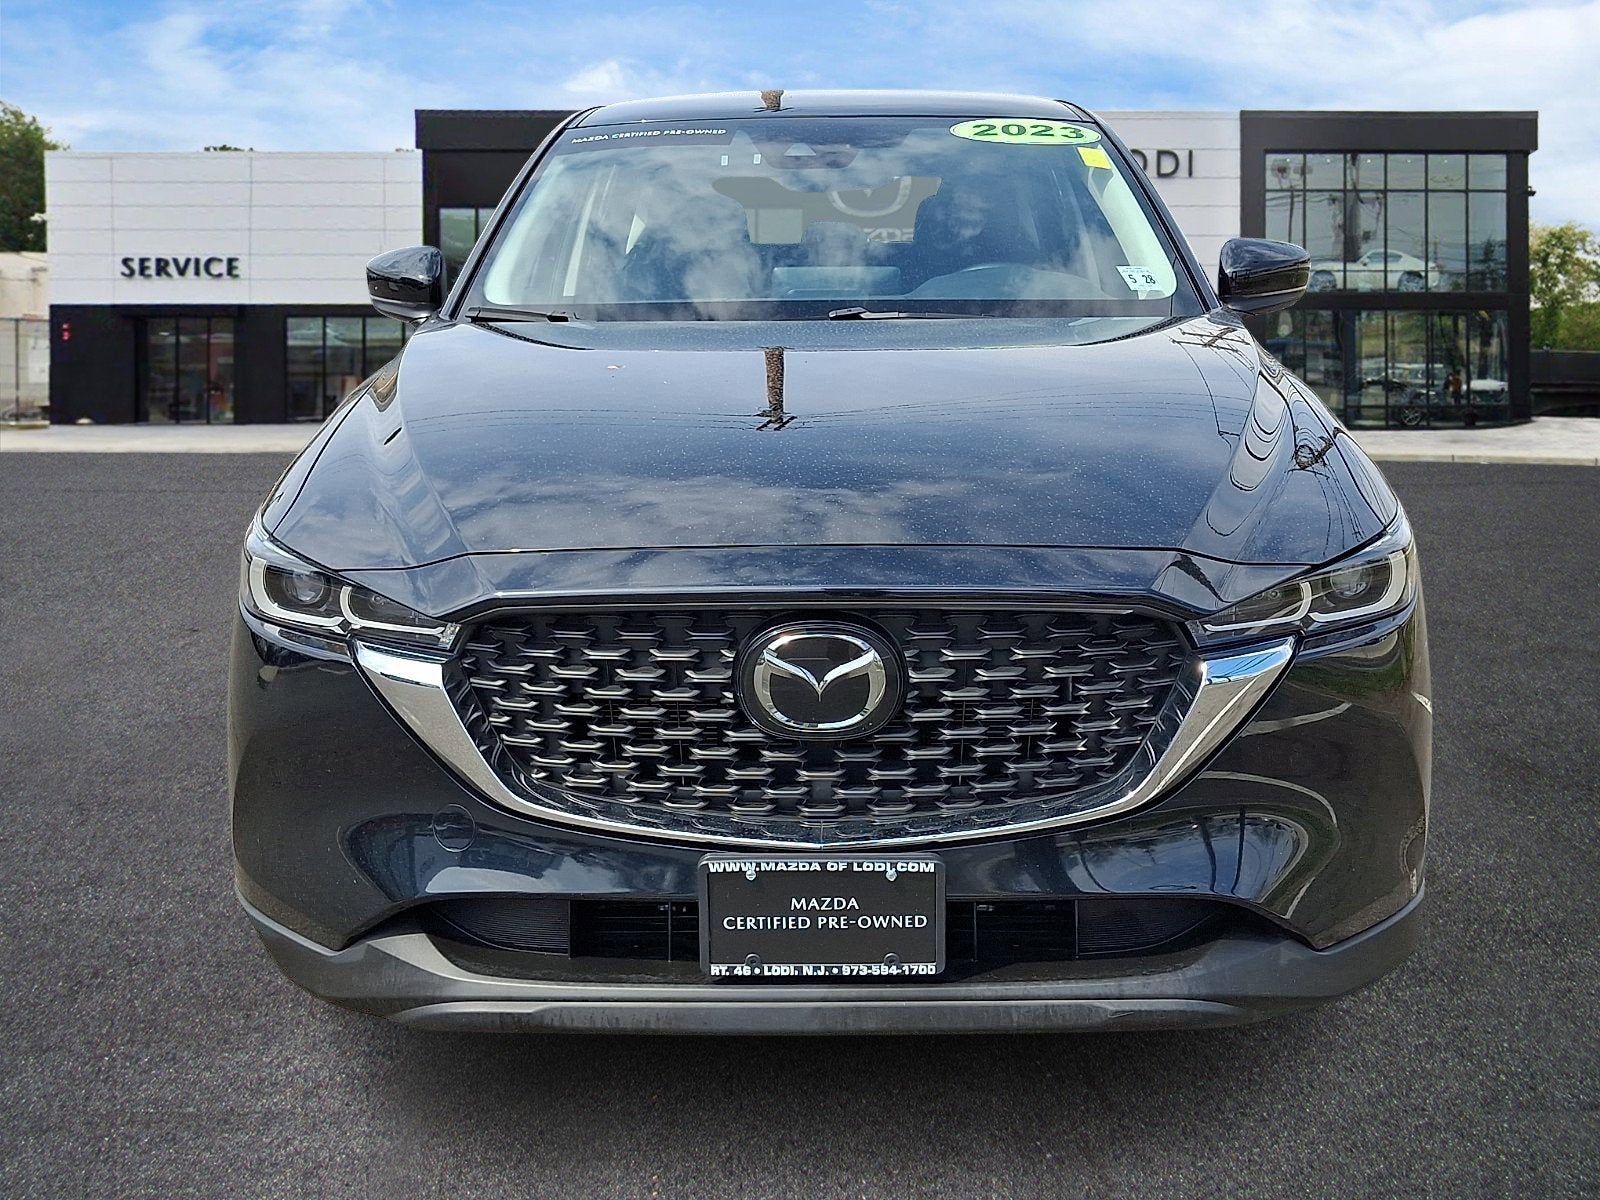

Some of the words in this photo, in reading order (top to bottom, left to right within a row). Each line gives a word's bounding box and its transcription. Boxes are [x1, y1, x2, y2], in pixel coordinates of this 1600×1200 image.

[571, 133, 609, 145] MAZDA
[612, 129, 661, 140] CERTIFIED
[663, 128, 727, 136] PRE-OWNED
[971, 123, 1086, 140] 2023
[120, 256, 240, 279] SERVICE
[1127, 274, 1138, 284] 5
[1141, 274, 1156, 285] 28
[708, 861, 822, 873] WWW.MAZDA
[826, 861, 848, 872] OF
[790, 897, 860, 911] MAZDA
[722, 916, 812, 930] CERTIFIED
[817, 915, 928, 929] PRE-OWNED
[710, 965, 730, 976] RT.
[733, 965, 752, 976] 46
